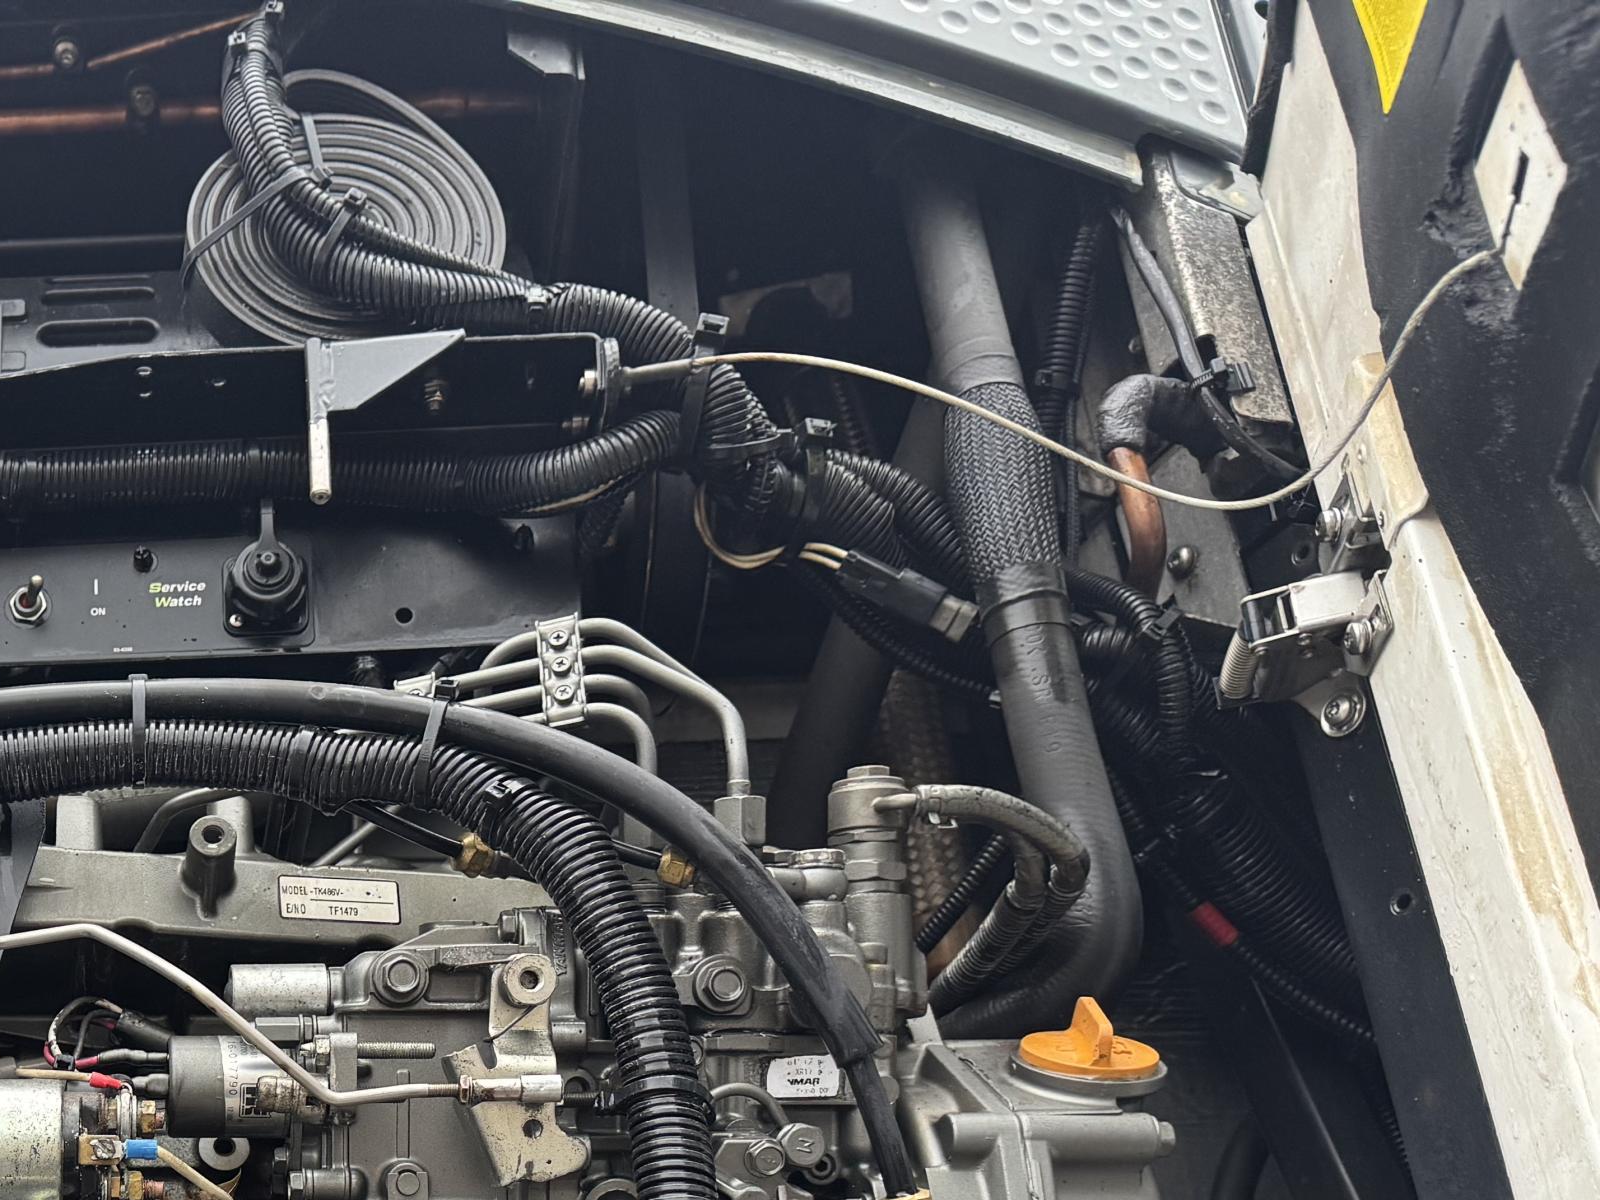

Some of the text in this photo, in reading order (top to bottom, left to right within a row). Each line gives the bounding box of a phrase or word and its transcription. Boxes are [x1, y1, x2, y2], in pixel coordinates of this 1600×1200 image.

[149, 581, 206, 593] Service
[155, 595, 202, 607] Watch
[90, 608, 106, 616] ON
[282, 885, 309, 896] MODEL
[329, 906, 359, 916] TF1479
